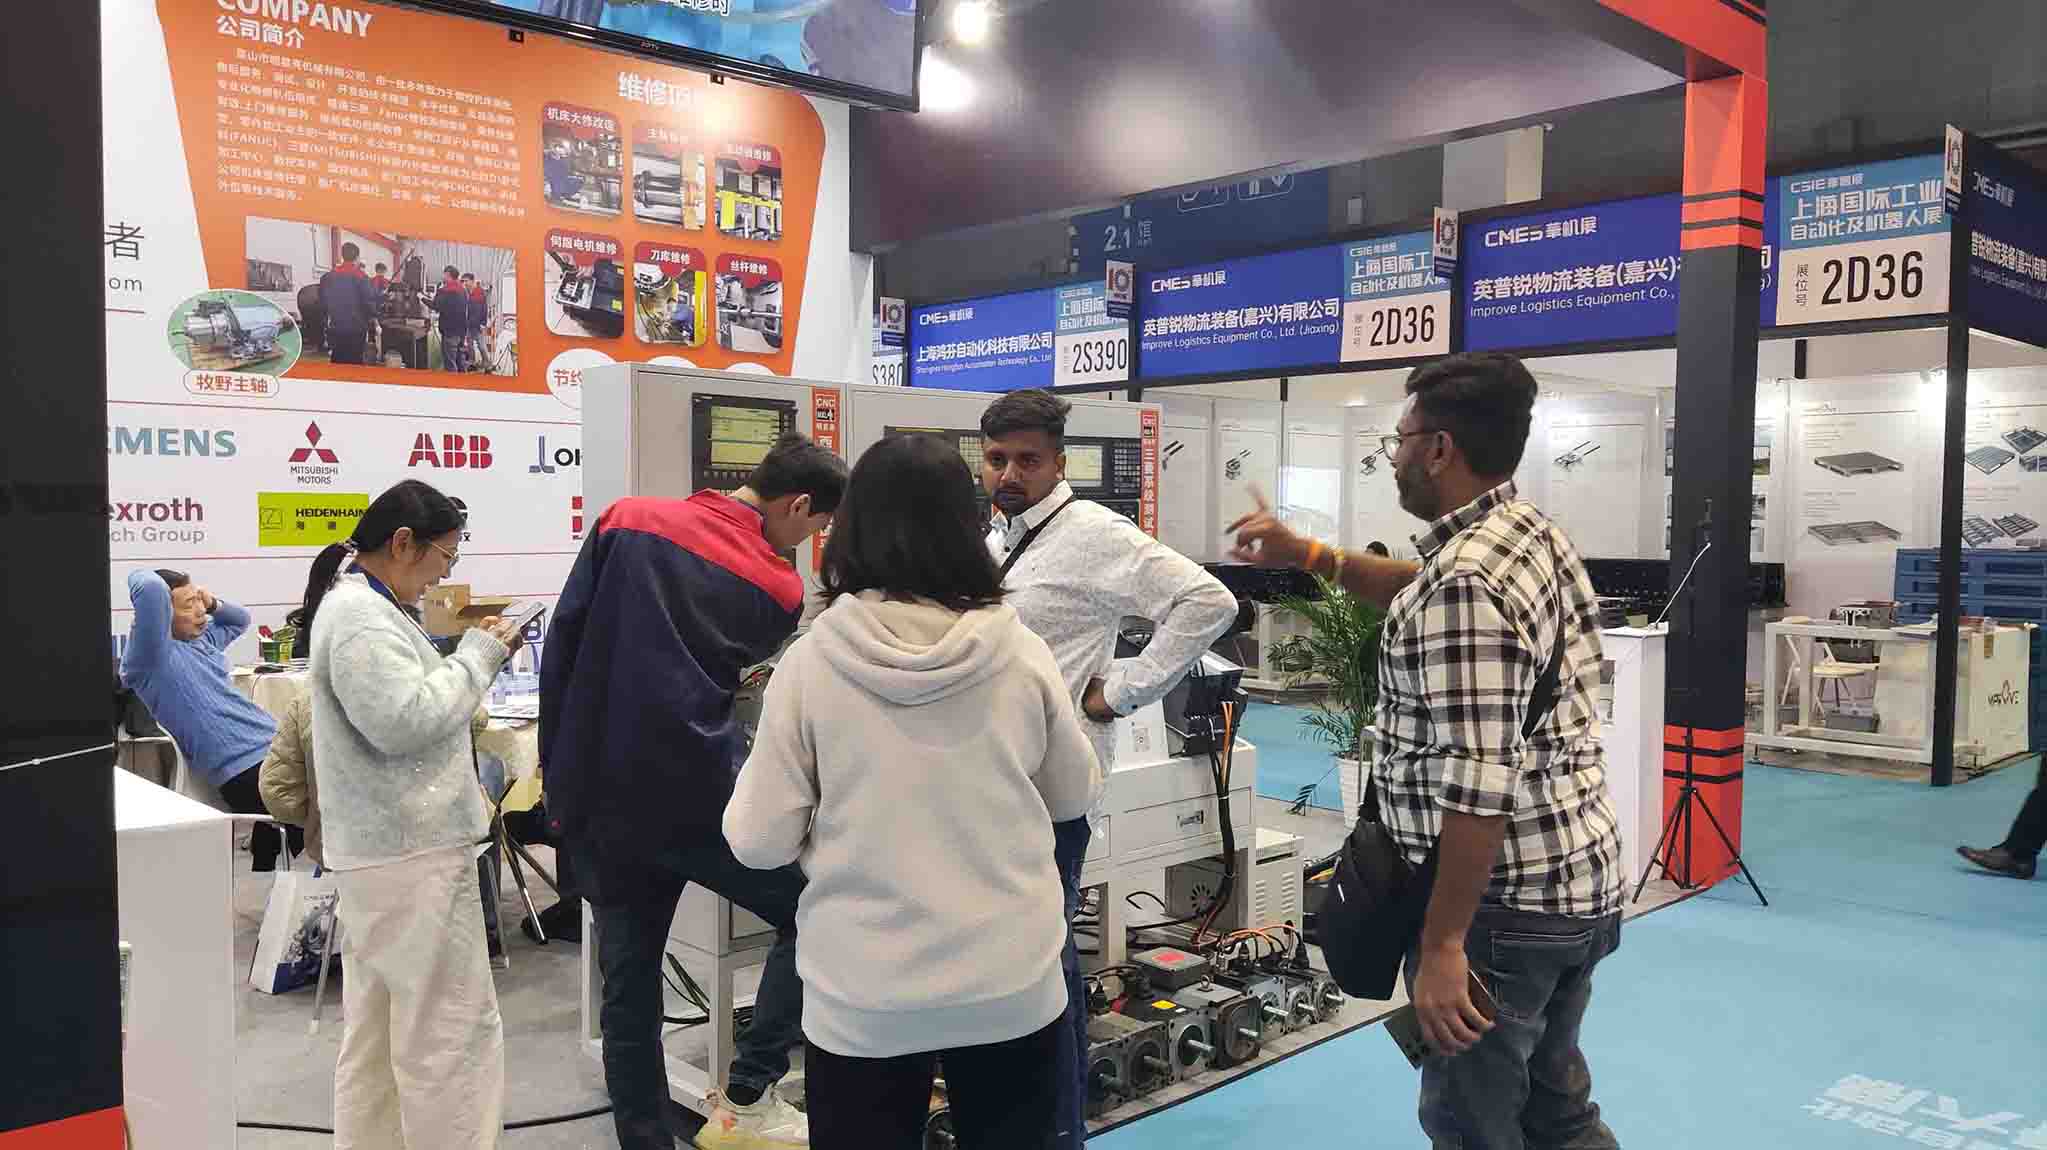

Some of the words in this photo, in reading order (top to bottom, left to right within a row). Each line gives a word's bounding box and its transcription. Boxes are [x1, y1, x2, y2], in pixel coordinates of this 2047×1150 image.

[216, 15, 304, 48] 公司简介
[1791, 178, 1944, 221] 上海国际工业
[1104, 224, 1131, 252] 2.1
[1485, 225, 1543, 247] CMES
[1791, 206, 1944, 241] 自动化及机器人展
[104, 221, 145, 261] 者
[550, 236, 617, 255] 伺服电机维修
[650, 249, 691, 265] 刀库维修
[1473, 255, 1680, 301] 英普锐物流装备(嘉兴)
[1795, 262, 1809, 308] 展位号
[1822, 250, 1924, 306] 2D36
[1470, 303, 1517, 318] Improve
[1520, 296, 1572, 314] Logistics
[1577, 290, 1645, 308] Equipment
[1650, 286, 1675, 300] Co.,
[1142, 340, 1173, 352] Improve
[1174, 335, 1211, 349] Logistics
[1213, 331, 1258, 346] Equipment
[1299, 321, 1340, 337] (Jiaxing)
[1370, 304, 1434, 347] 2D36
[1072, 338, 1127, 374] 2S390
[196, 373, 268, 393] 牧野主轴
[816, 398, 835, 408] CNC
[107, 425, 238, 458] MENS
[408, 433, 493, 468] ABB
[290, 466, 339, 475] MITSUBISHI
[297, 475, 332, 485] MOTORS
[142, 526, 204, 544] Group
